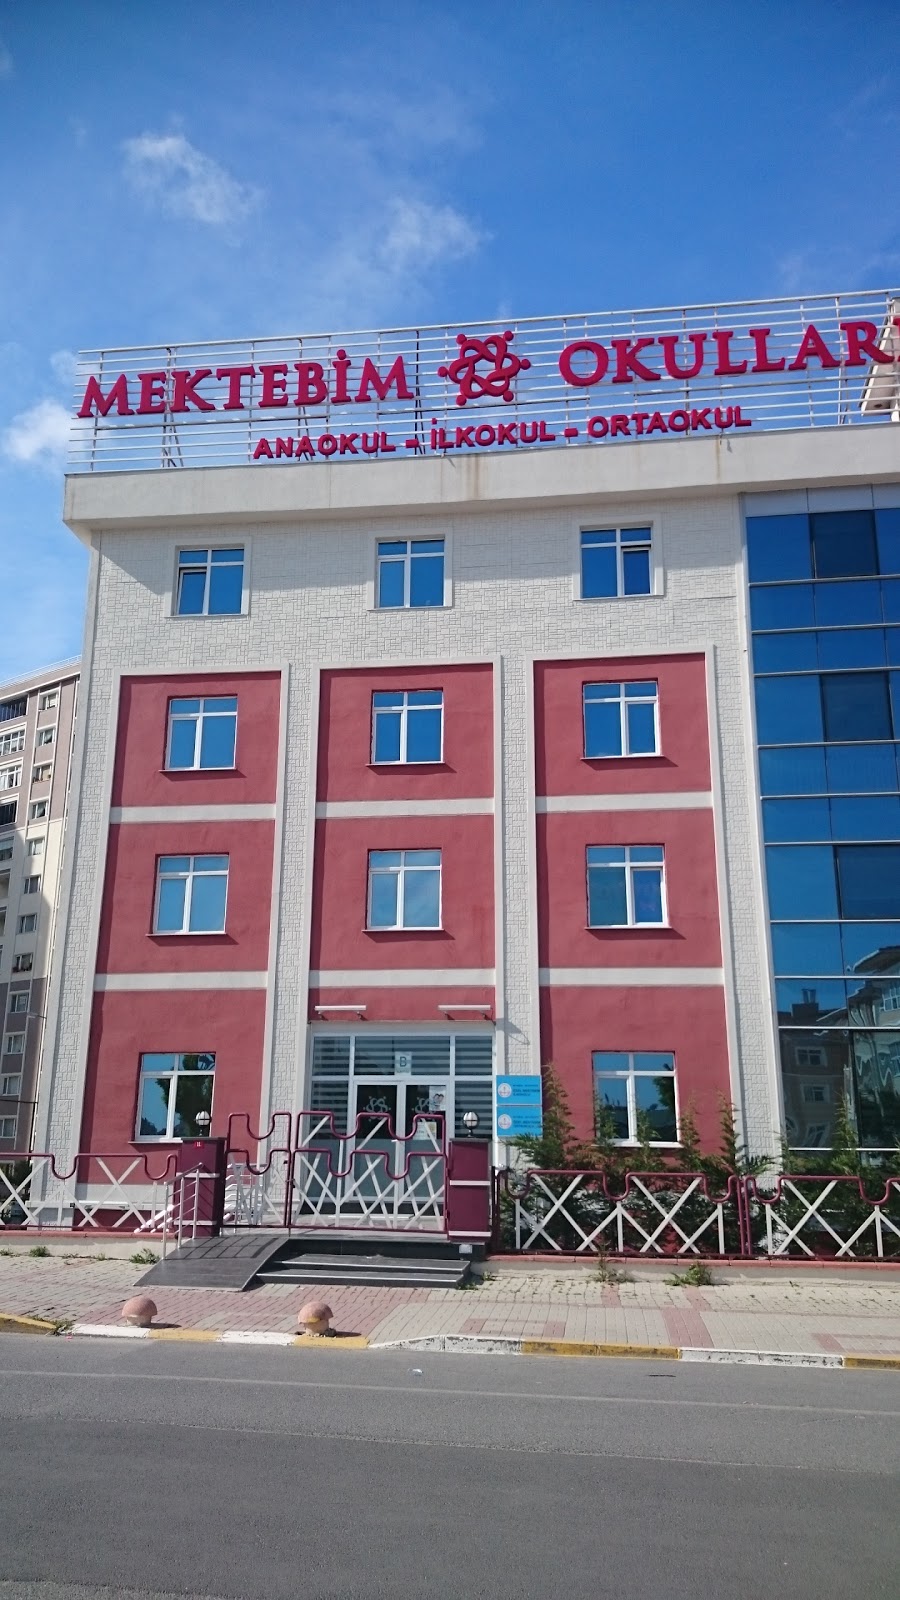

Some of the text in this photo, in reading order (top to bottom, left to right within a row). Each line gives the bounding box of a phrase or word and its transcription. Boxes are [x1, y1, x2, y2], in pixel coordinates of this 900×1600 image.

[77, 349, 414, 418] MEKTEBİM
[253, 431, 396, 460] ANAOKUL
[431, 417, 555, 450] İLKOKUL
[587, 405, 752, 438] ORTAOKUL
[399, 1056, 408, 1068] B
